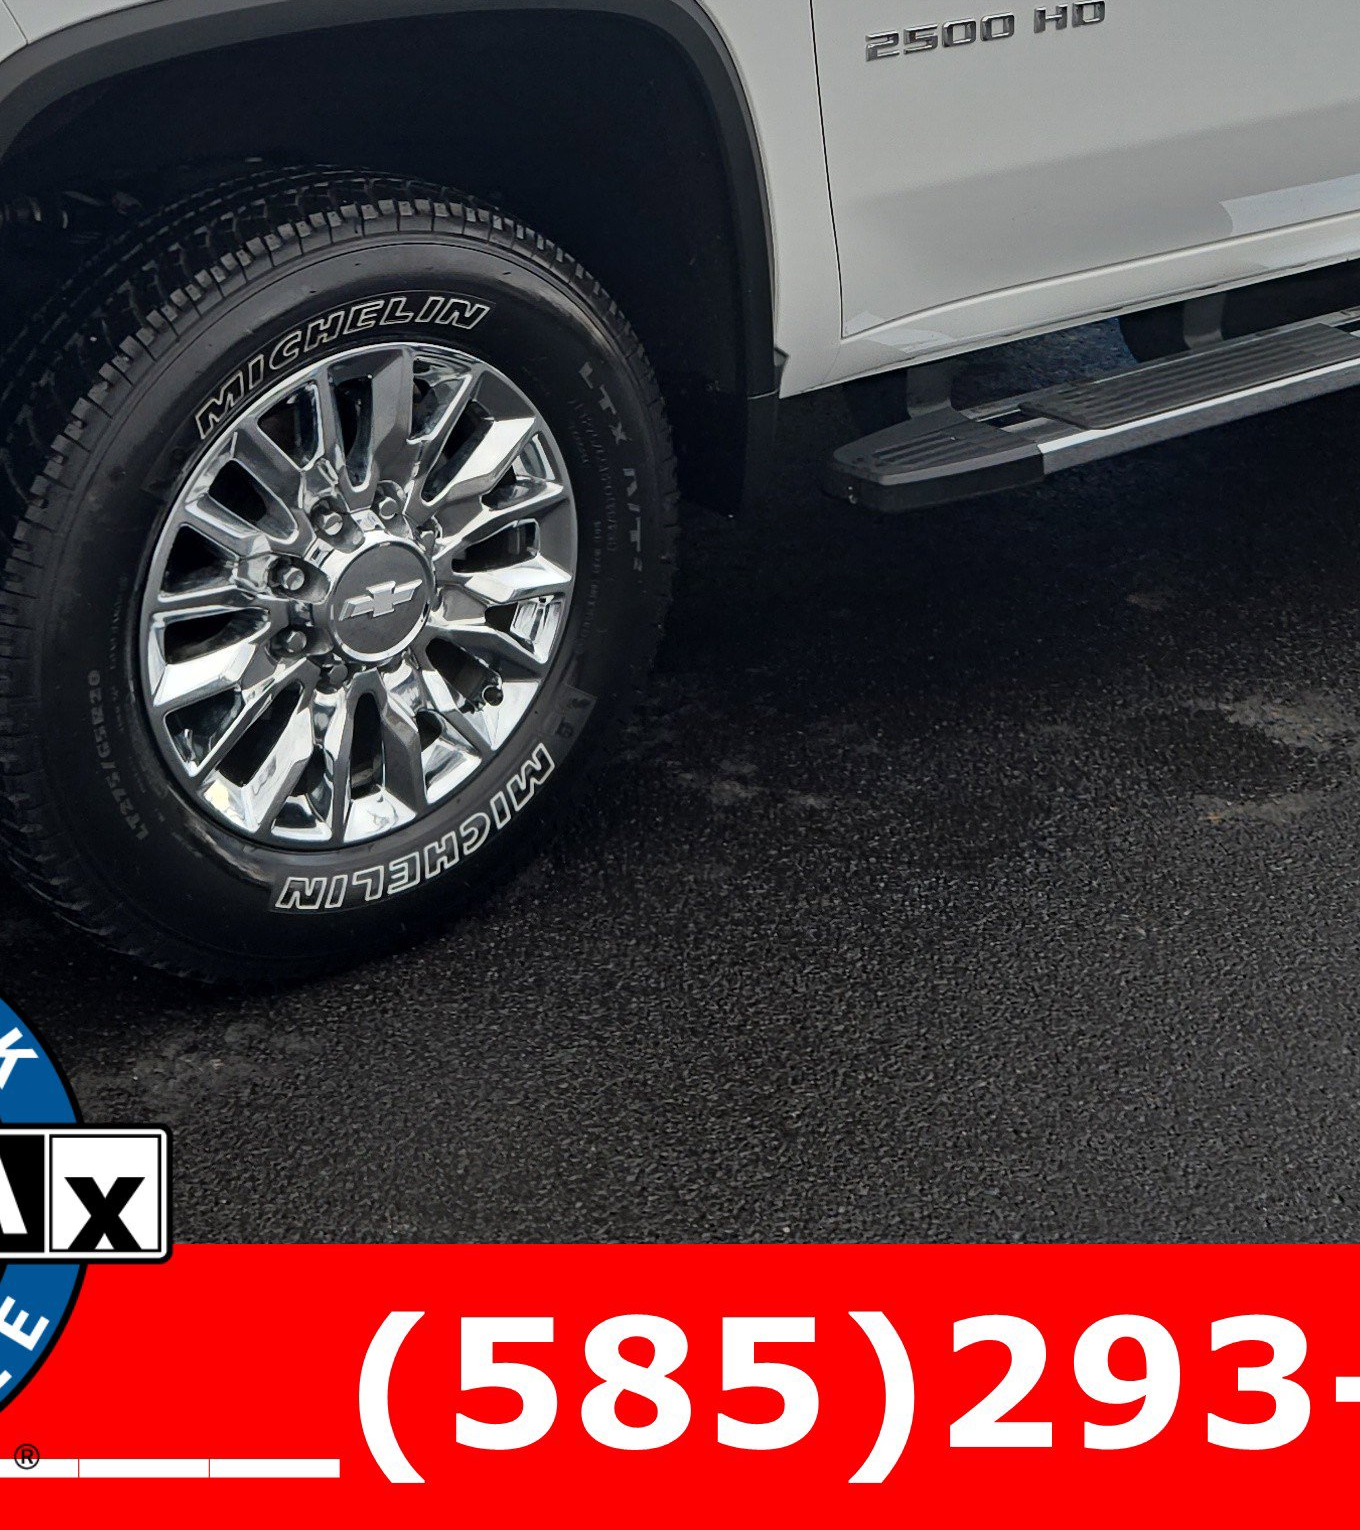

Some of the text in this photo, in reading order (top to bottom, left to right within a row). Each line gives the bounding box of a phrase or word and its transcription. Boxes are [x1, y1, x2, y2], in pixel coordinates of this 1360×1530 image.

[865, 12, 1016, 62] 2500
[196, 296, 491, 440] MICHELIN
[275, 744, 556, 911] MICHELIN
